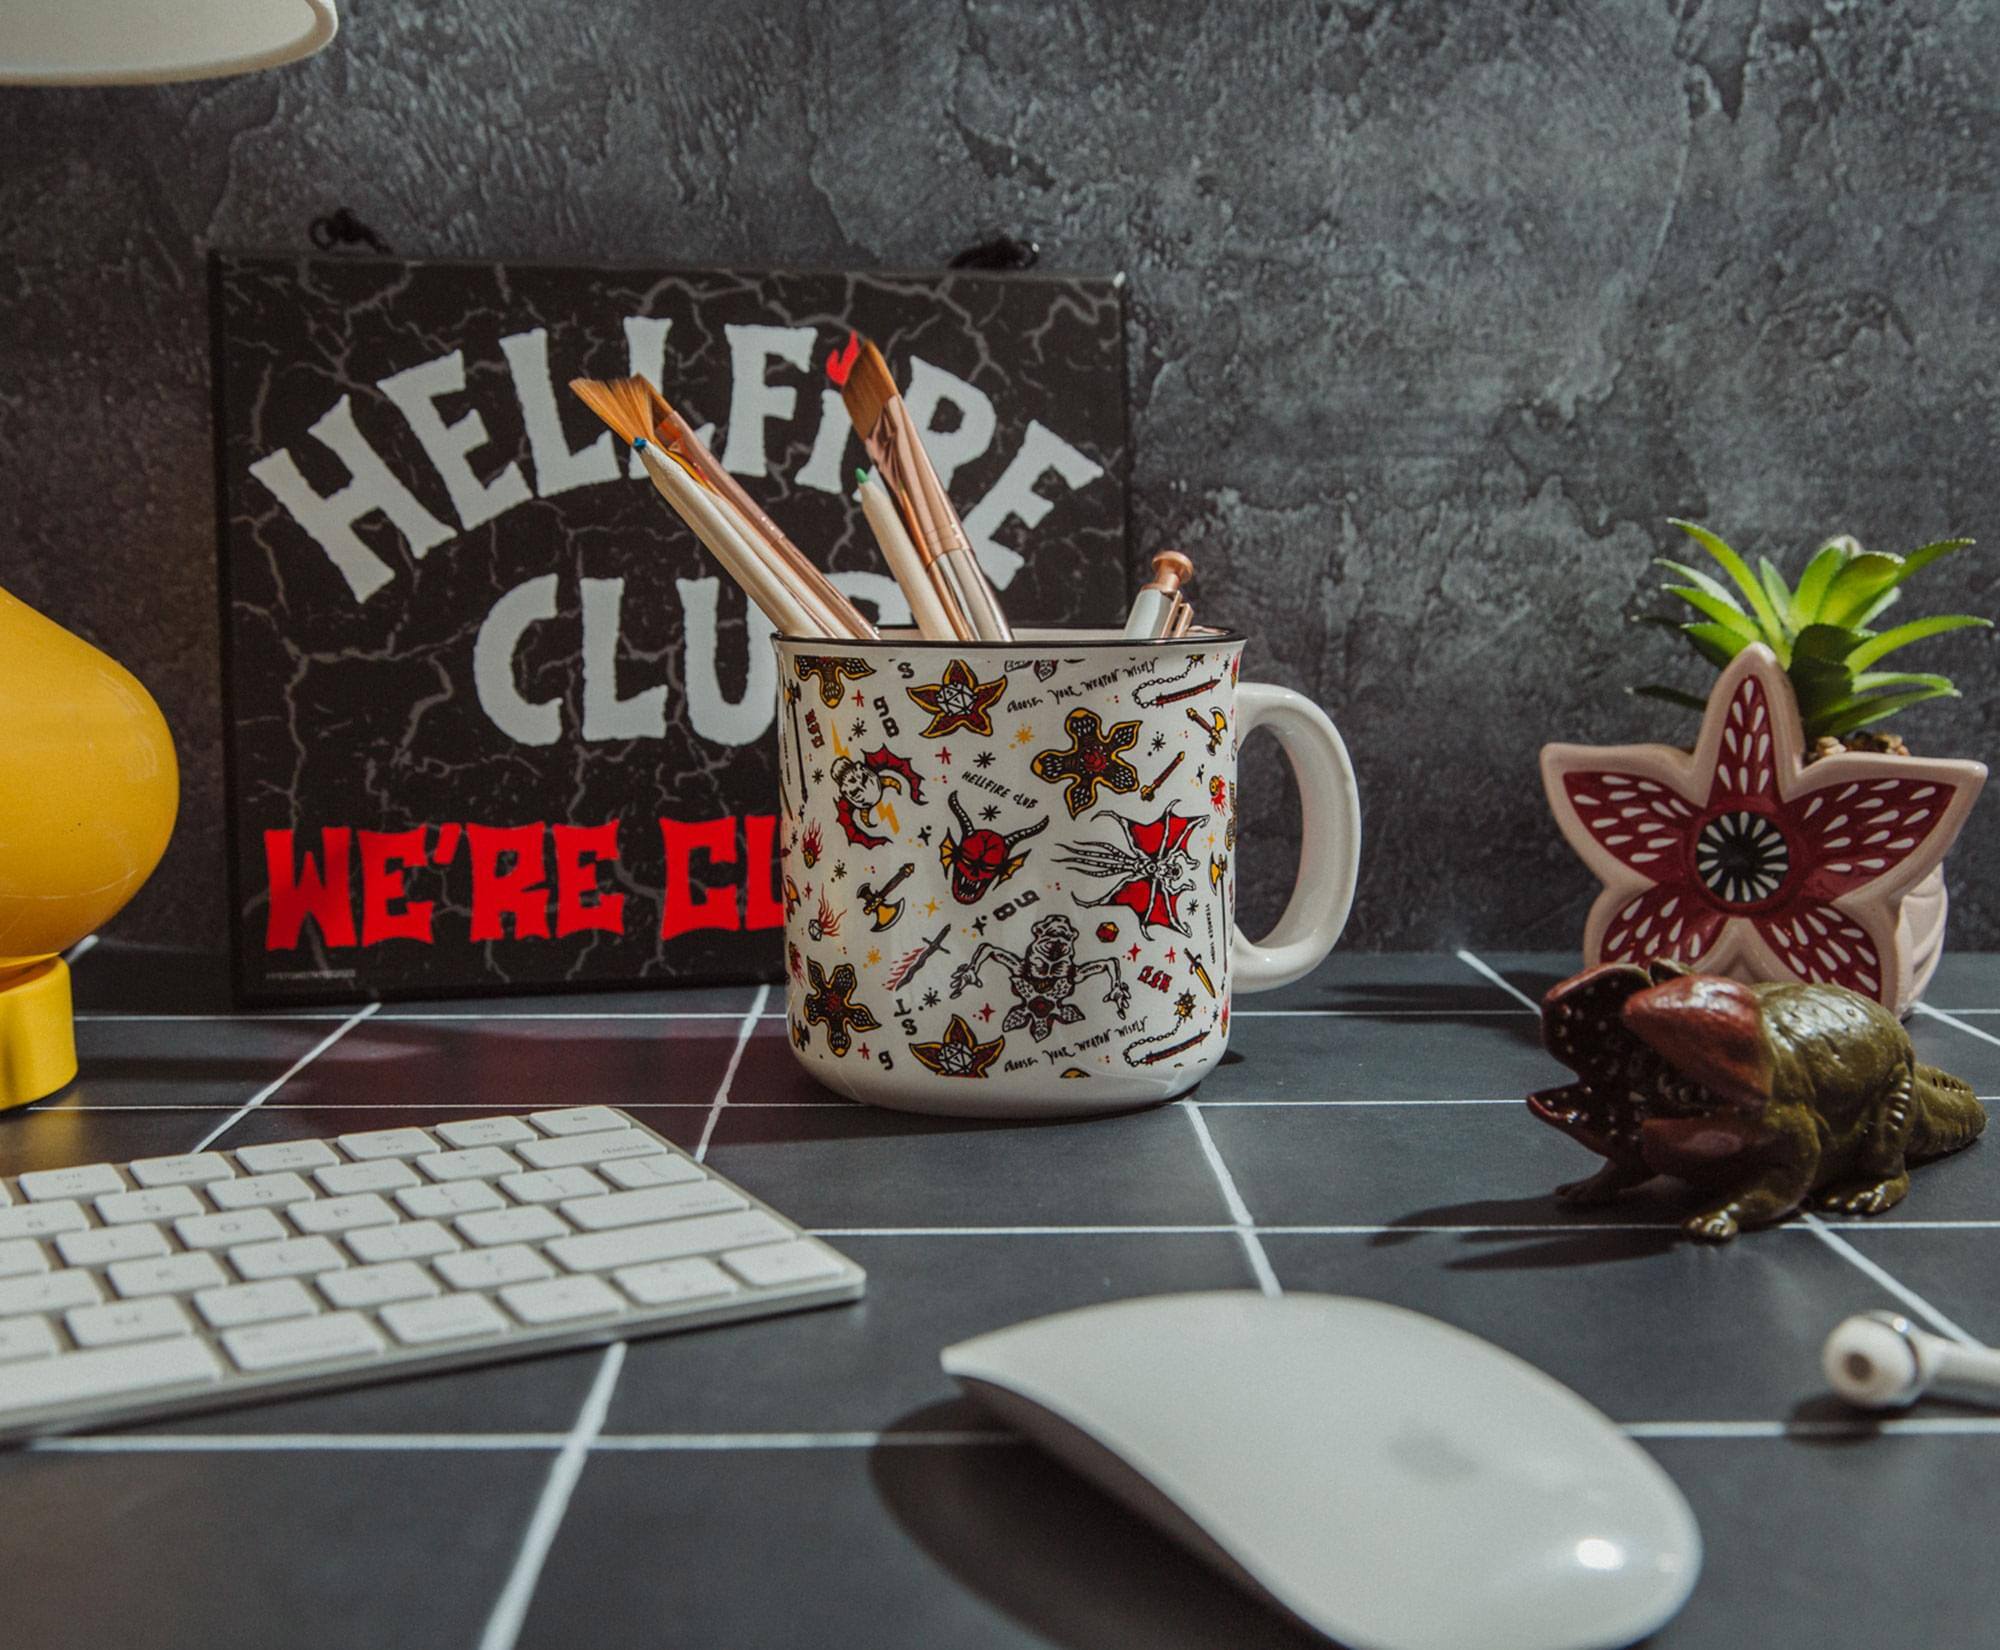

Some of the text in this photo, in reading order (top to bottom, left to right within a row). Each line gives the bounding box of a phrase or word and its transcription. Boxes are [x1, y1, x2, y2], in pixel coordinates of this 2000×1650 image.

[249, 317, 1104, 603] HELLFIRE
[1080, 669, 1120, 692] WEAPON
[1123, 657, 1159, 678] WISELY
[961, 770, 1011, 798] HELLFIRE
[264, 815, 785, 951] WE'RE CL
[1075, 1029, 1112, 1052] WEAPON
[1114, 1016, 1147, 1038] WISELY
